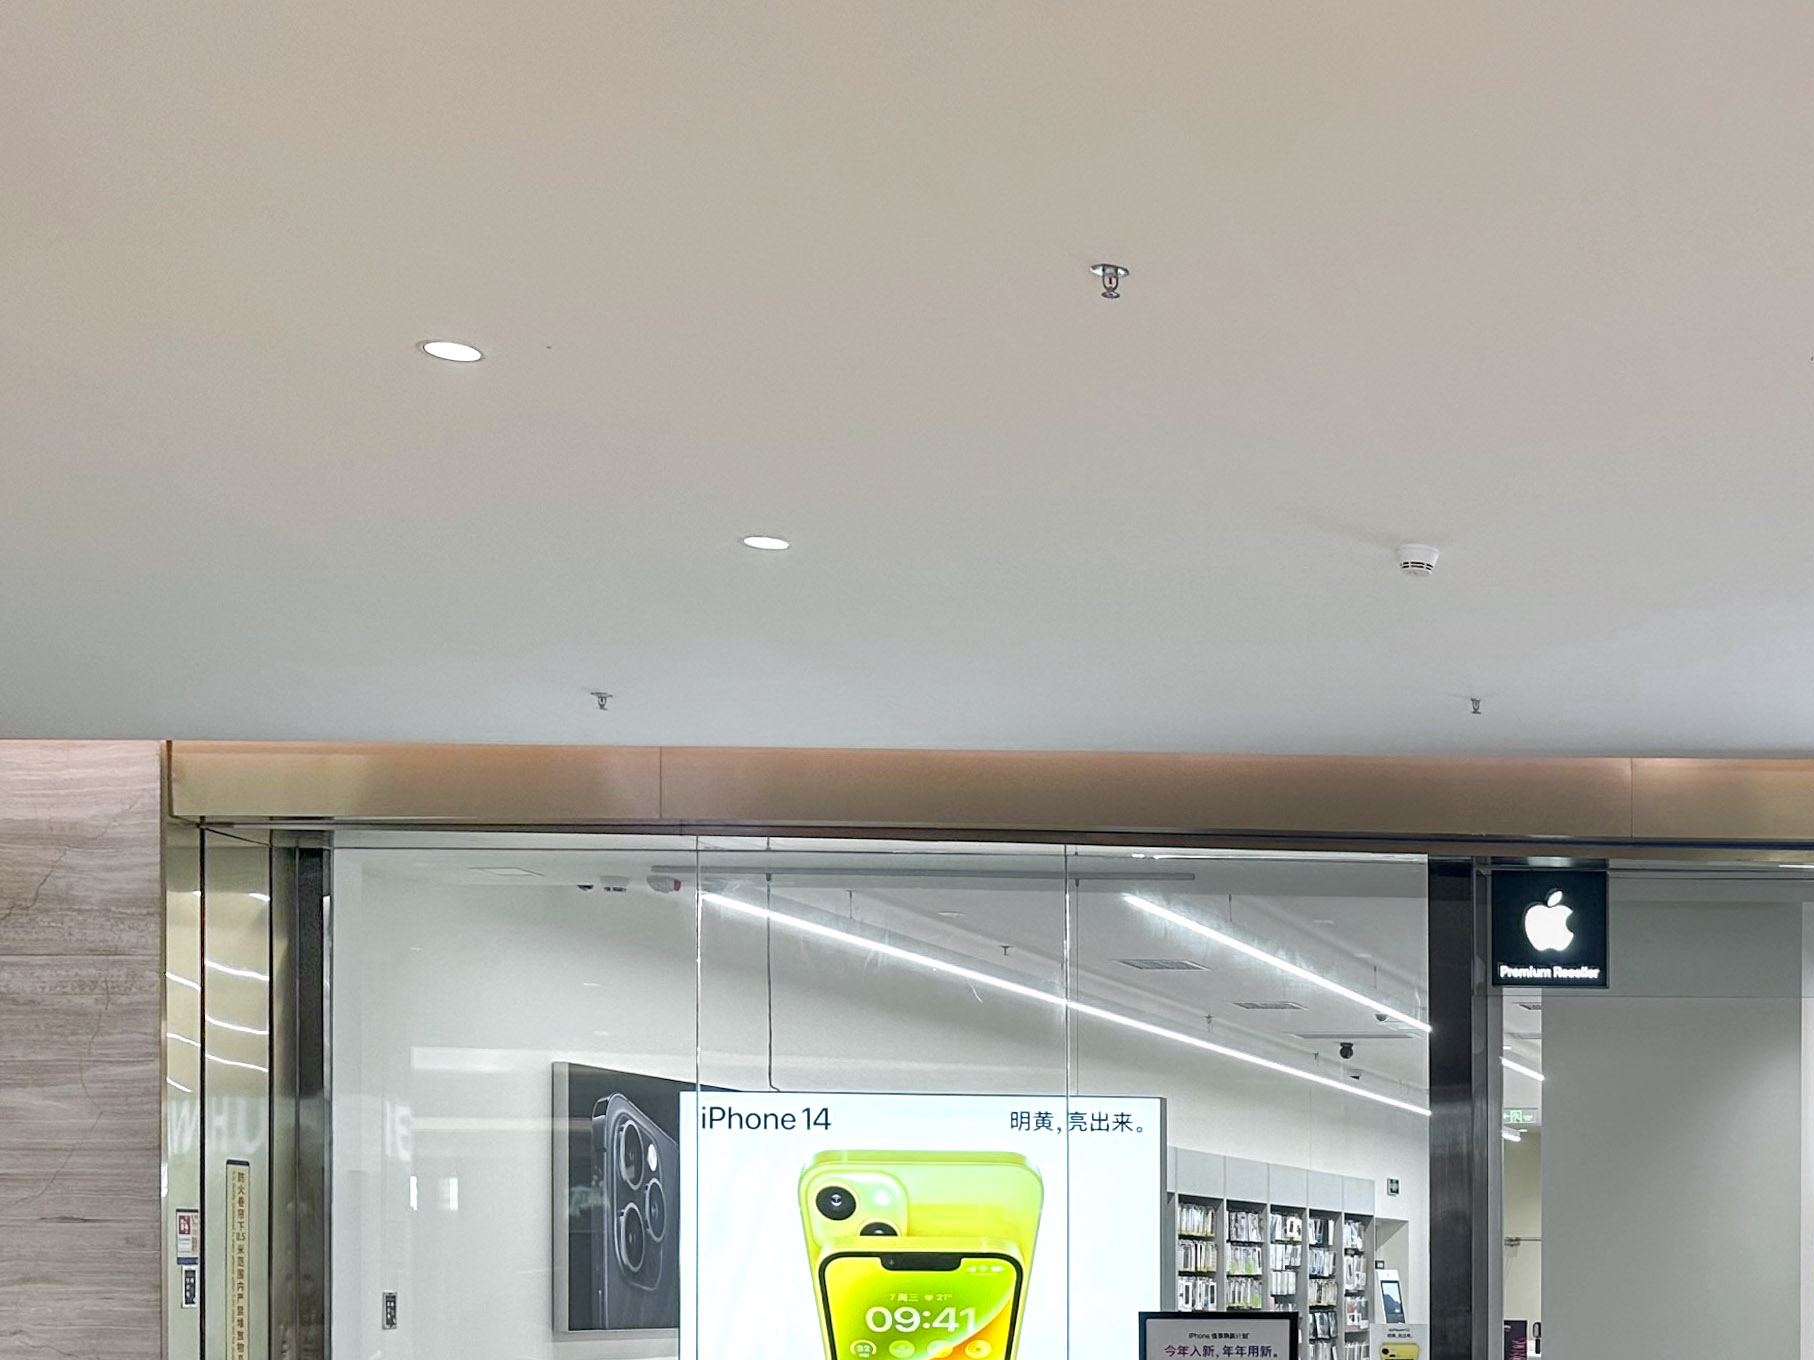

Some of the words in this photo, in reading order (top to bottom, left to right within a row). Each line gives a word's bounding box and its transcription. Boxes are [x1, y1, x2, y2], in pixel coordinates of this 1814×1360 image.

[1499, 965, 1552, 979] Premium
[701, 1105, 797, 1131] iPhone
[801, 1106, 832, 1131] 14
[865, 1306, 976, 1333] 09:41
